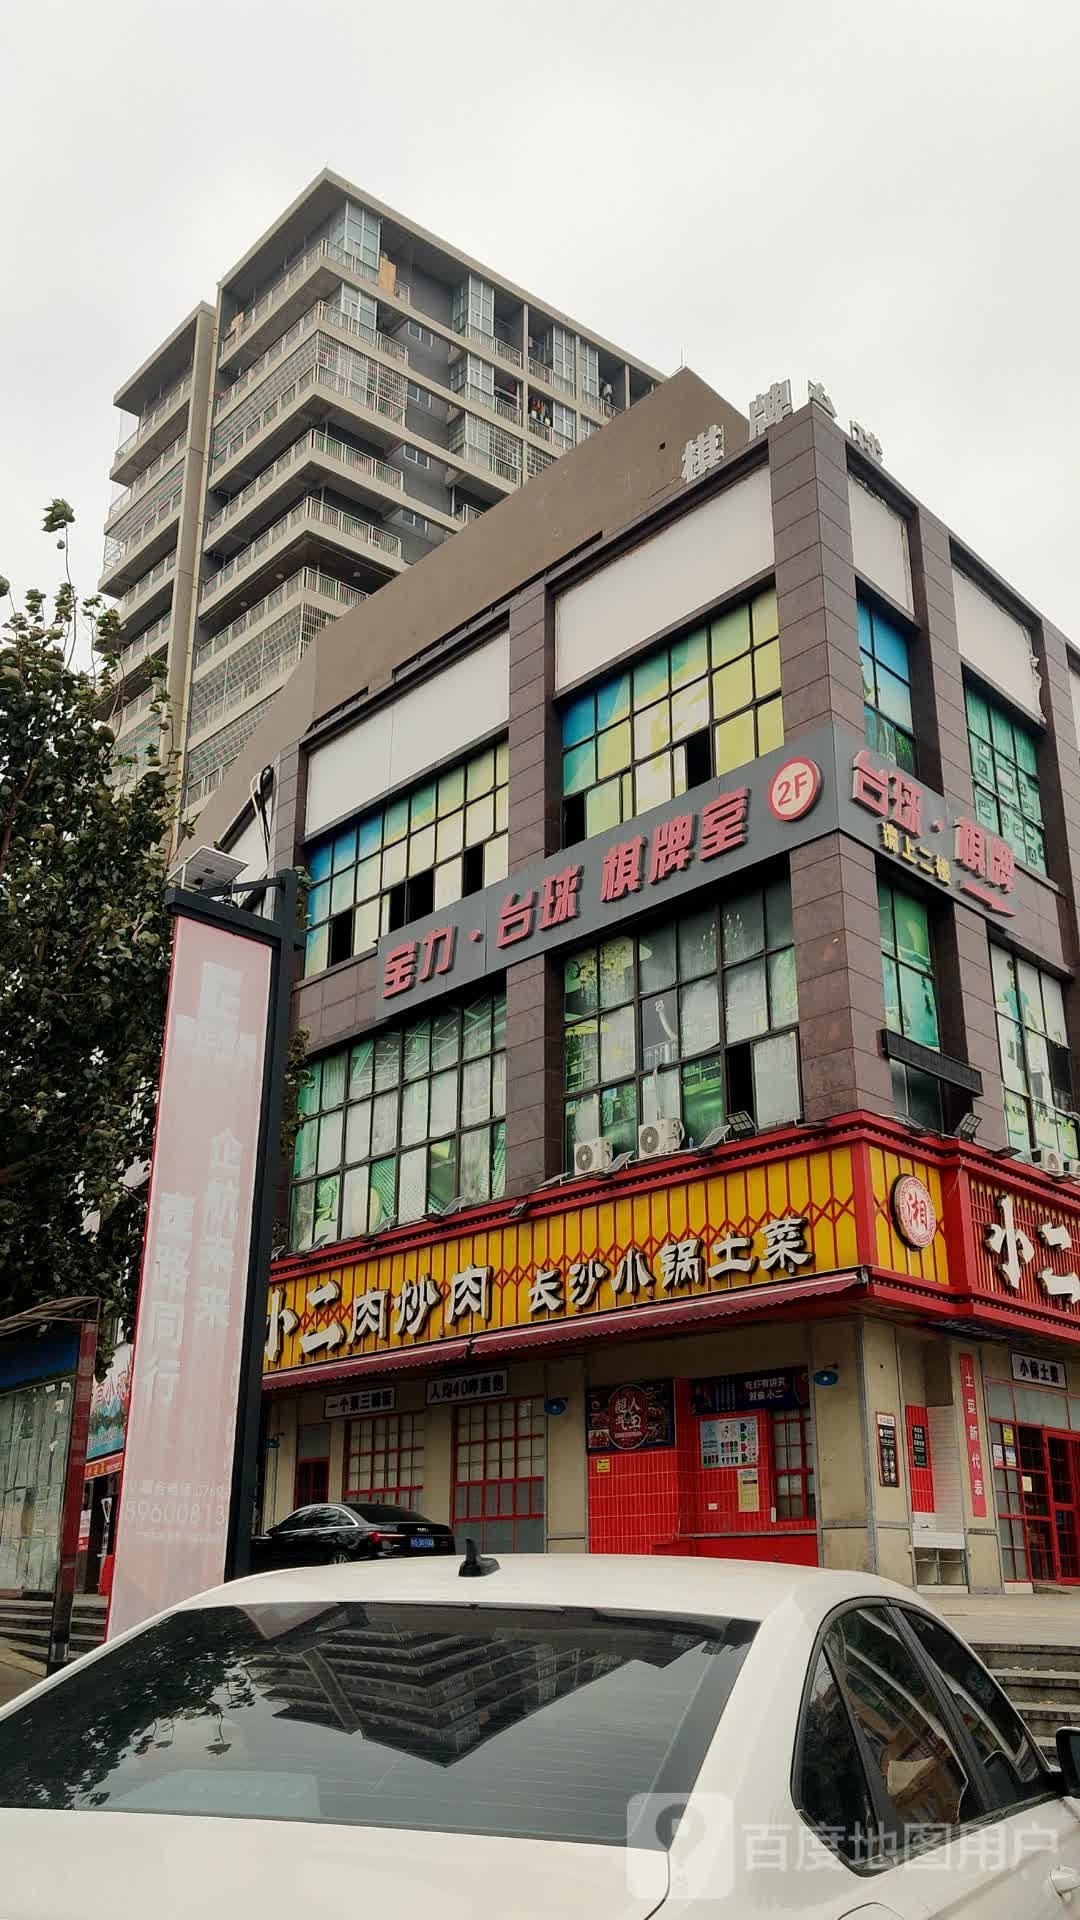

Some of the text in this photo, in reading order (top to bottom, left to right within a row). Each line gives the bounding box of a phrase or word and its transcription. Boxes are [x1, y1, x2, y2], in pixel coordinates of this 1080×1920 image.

[600, 786, 751, 903] 棋牌室
[777, 771, 808, 806] 2F
[852, 750, 1015, 894] 台球·棋牌
[265, 1216, 813, 1362] 小二肉炒肉 长沙小锅土菜
[985, 1194, 1080, 1305] 小二
